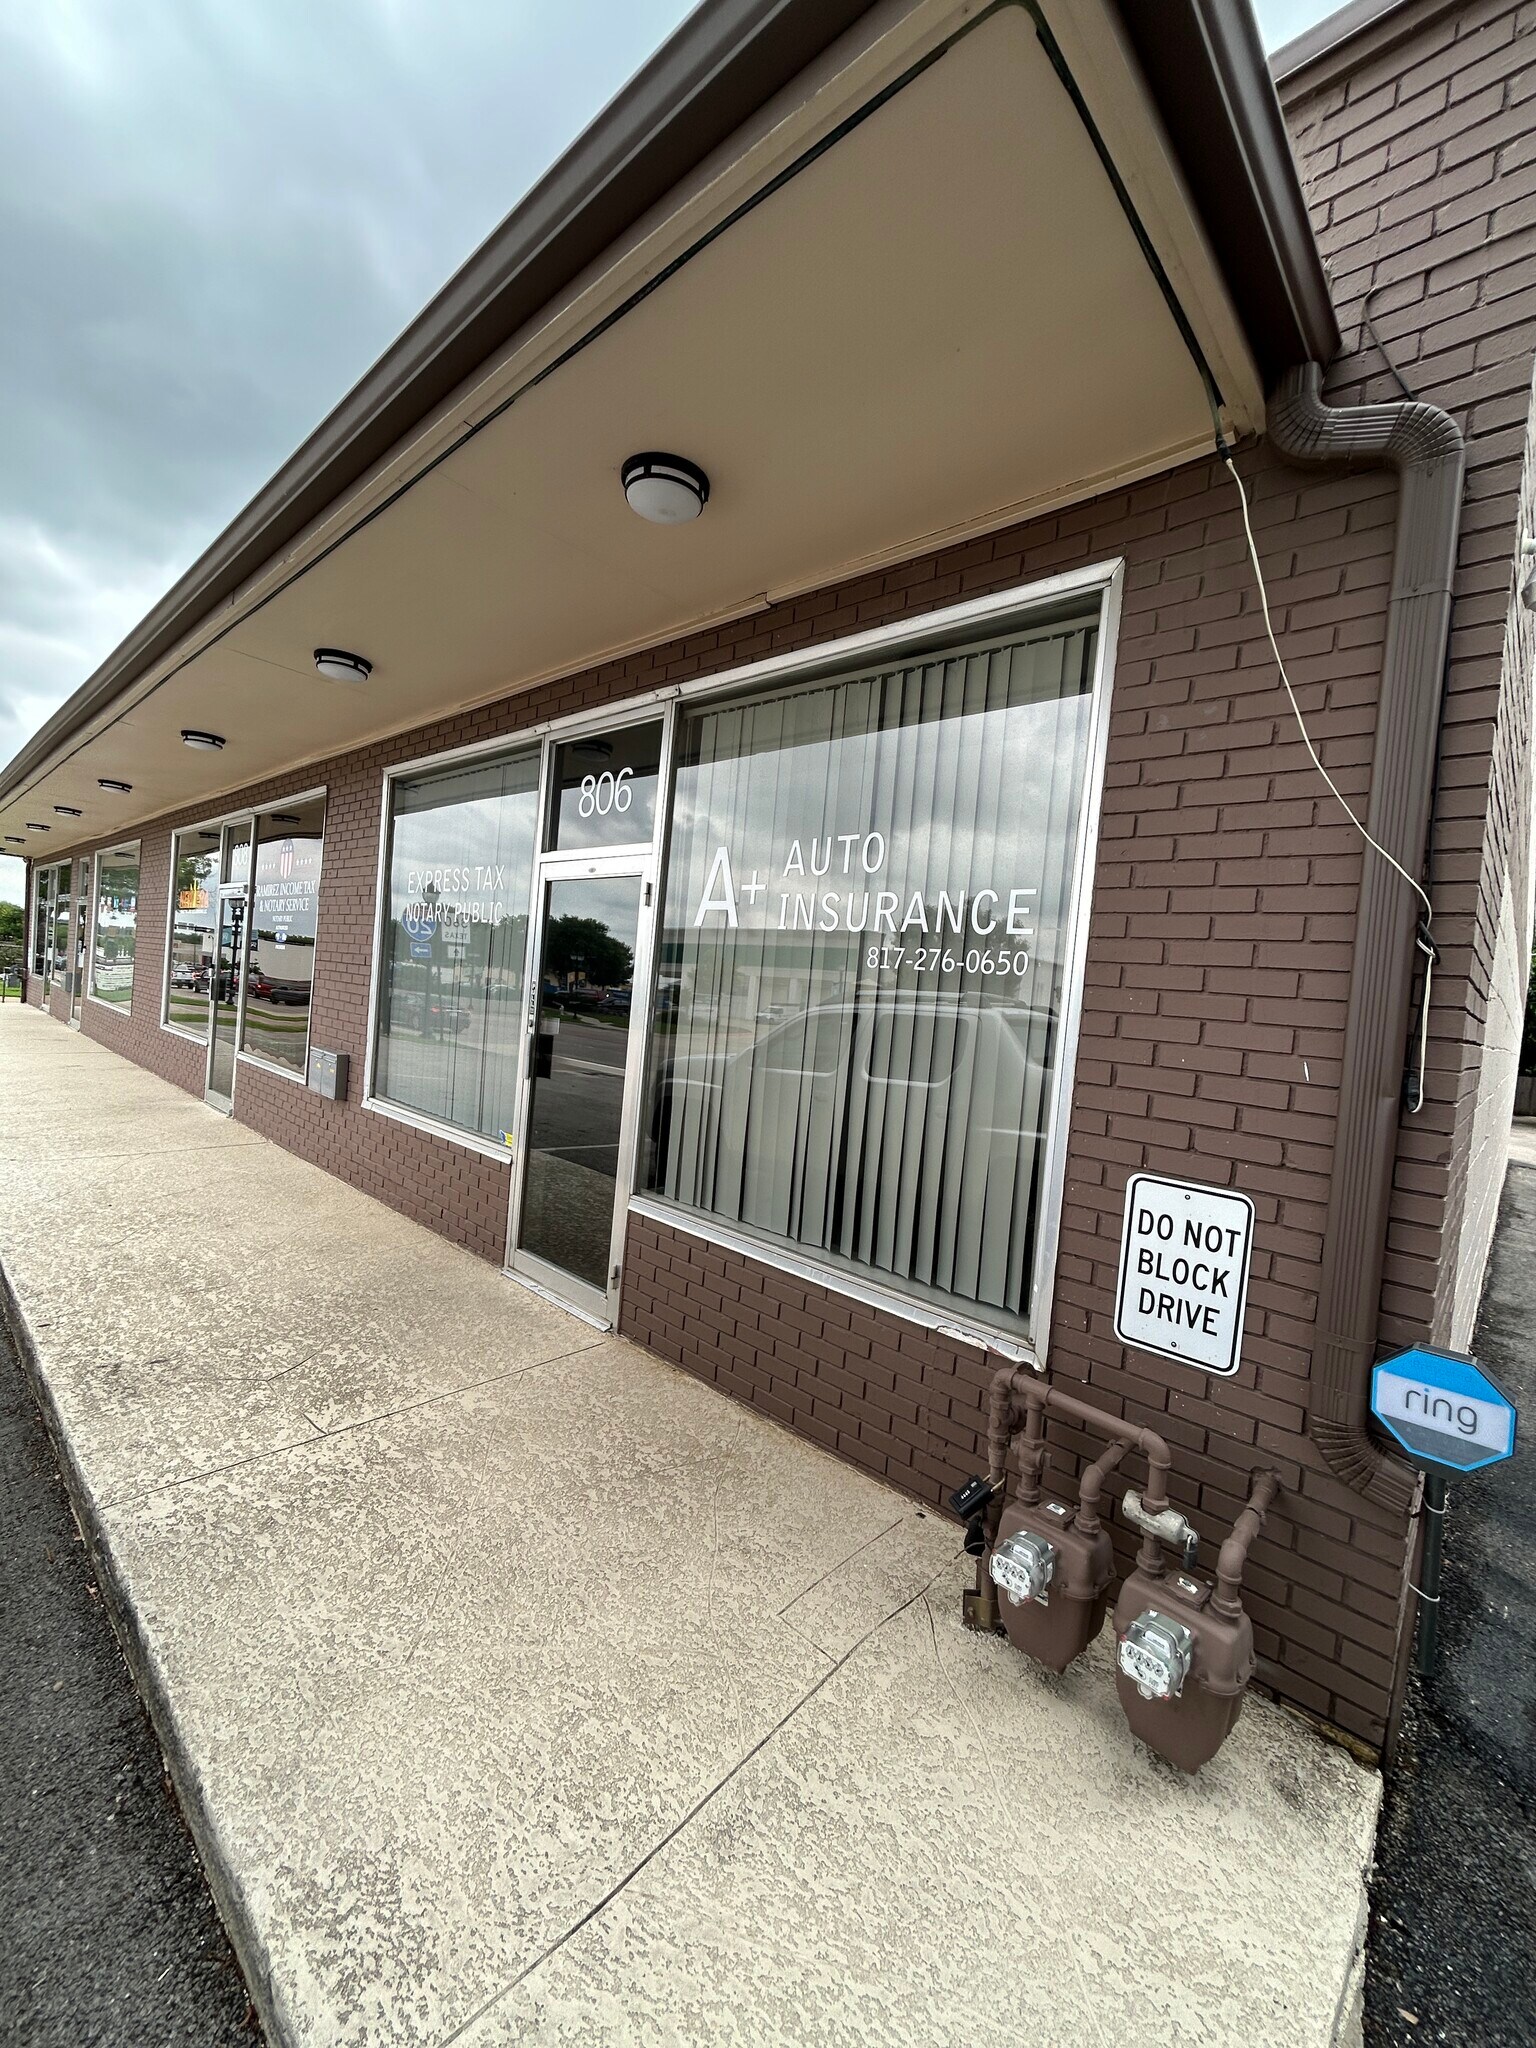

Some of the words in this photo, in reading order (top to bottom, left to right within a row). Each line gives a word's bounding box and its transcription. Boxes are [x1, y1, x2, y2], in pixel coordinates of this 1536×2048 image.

[579, 767, 633, 818] 806
[783, 831, 885, 877] AUTO
[280, 881, 303, 896] INCOME
[303, 880, 316, 894] TAX
[407, 868, 470, 894] EXPRESS
[475, 864, 505, 891] TAX
[694, 846, 768, 928] A+
[264, 899, 286, 912] NOTARY
[286, 897, 310, 911] SERVICE
[405, 902, 450, 923] NOTARY
[454, 901, 503, 925] PUBLIC
[777, 888, 1038, 936] INSURANCE
[866, 946, 1029, 976] 817-276-0650
[1137, 1208, 1174, 1241] DO
[1184, 1219, 1242, 1257] NOT
[1137, 1247, 1231, 1298] BLOCK
[1138, 1287, 1221, 1337] DRIVE
[1405, 1388, 1478, 1435] ring
